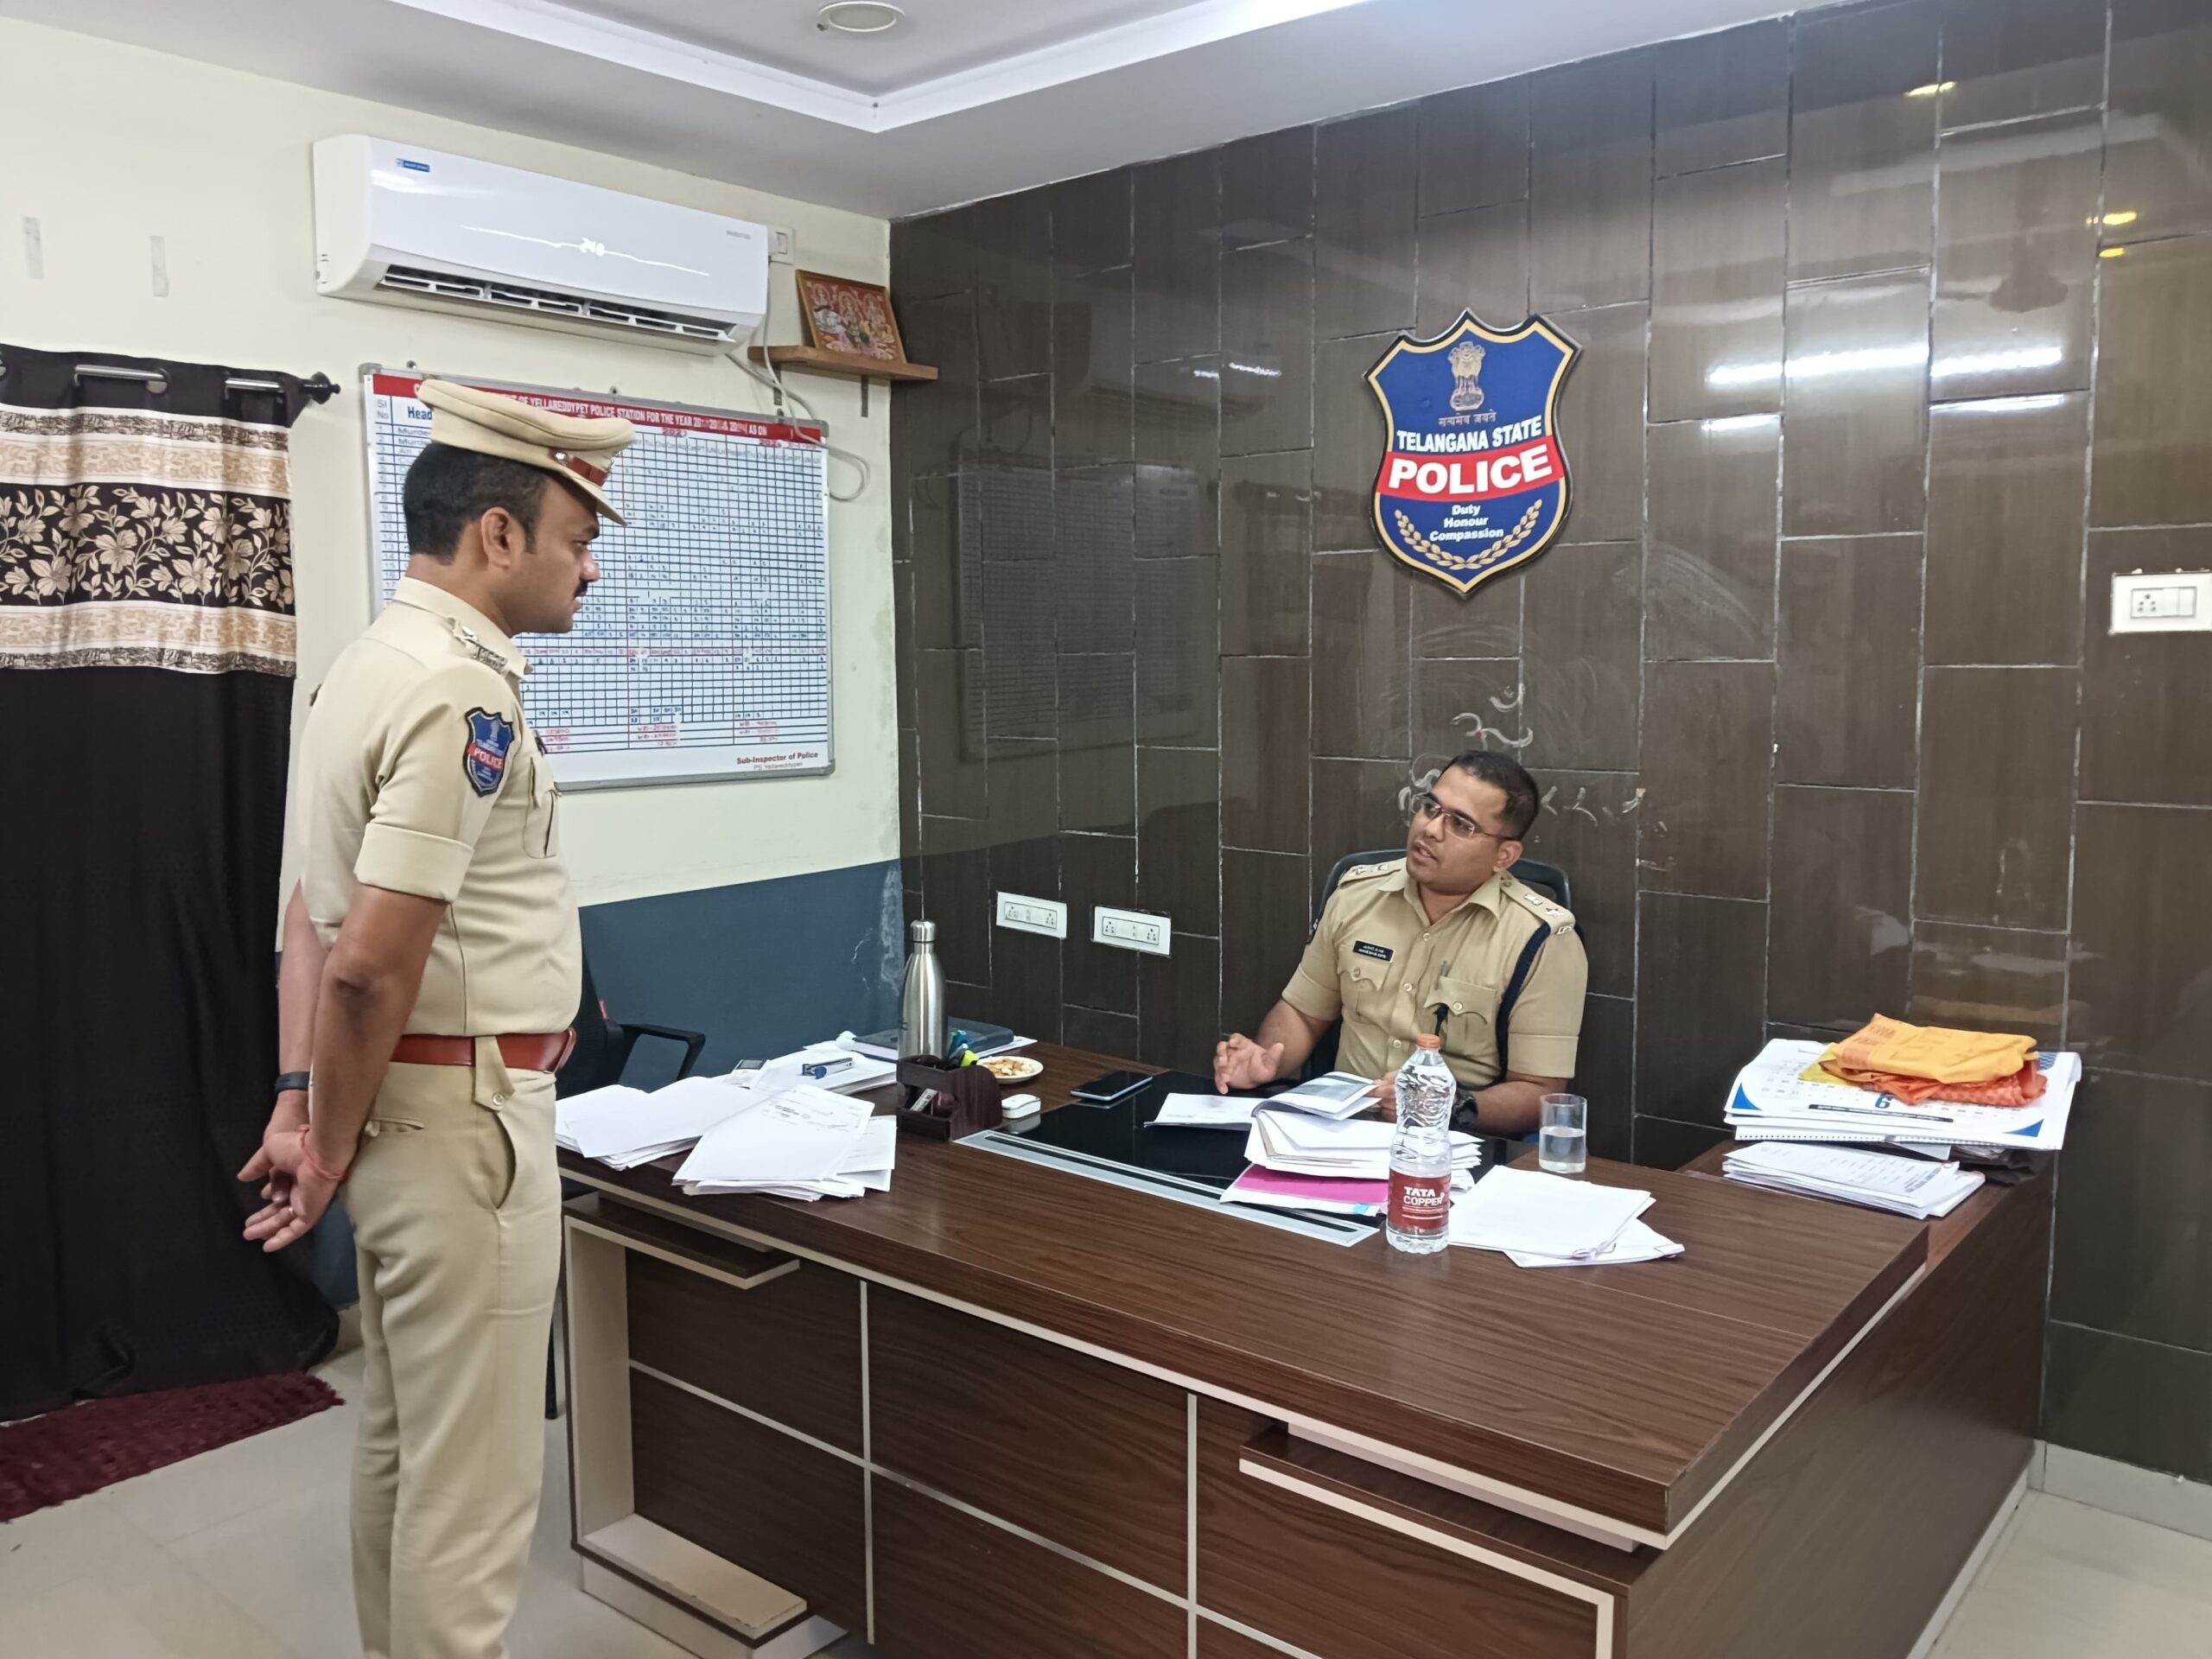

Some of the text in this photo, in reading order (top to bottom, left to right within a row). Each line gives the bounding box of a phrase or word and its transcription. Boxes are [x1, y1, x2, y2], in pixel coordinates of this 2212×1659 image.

[408, 406, 432, 420] Head
[590, 404, 615, 417] POLICE
[617, 408, 645, 422] STATION
[646, 411, 660, 423] FOR
[661, 413, 674, 425] THE
[675, 415, 692, 427] YEAR
[748, 423, 757, 435] AS
[758, 425, 767, 436] ON
[1396, 415, 1542, 453] TELANGANA STATE
[1389, 444, 1553, 494] POLICE
[1452, 504, 1481, 517] Duty
[1443, 516, 1489, 528] Honour
[1429, 528, 1503, 542] Compassion
[474, 747, 505, 770] POLICE
[736, 755, 786, 765] Sub-Inspector
[1403, 1185, 1436, 1198] TATA
[1403, 1192, 1446, 1206] COPPER
